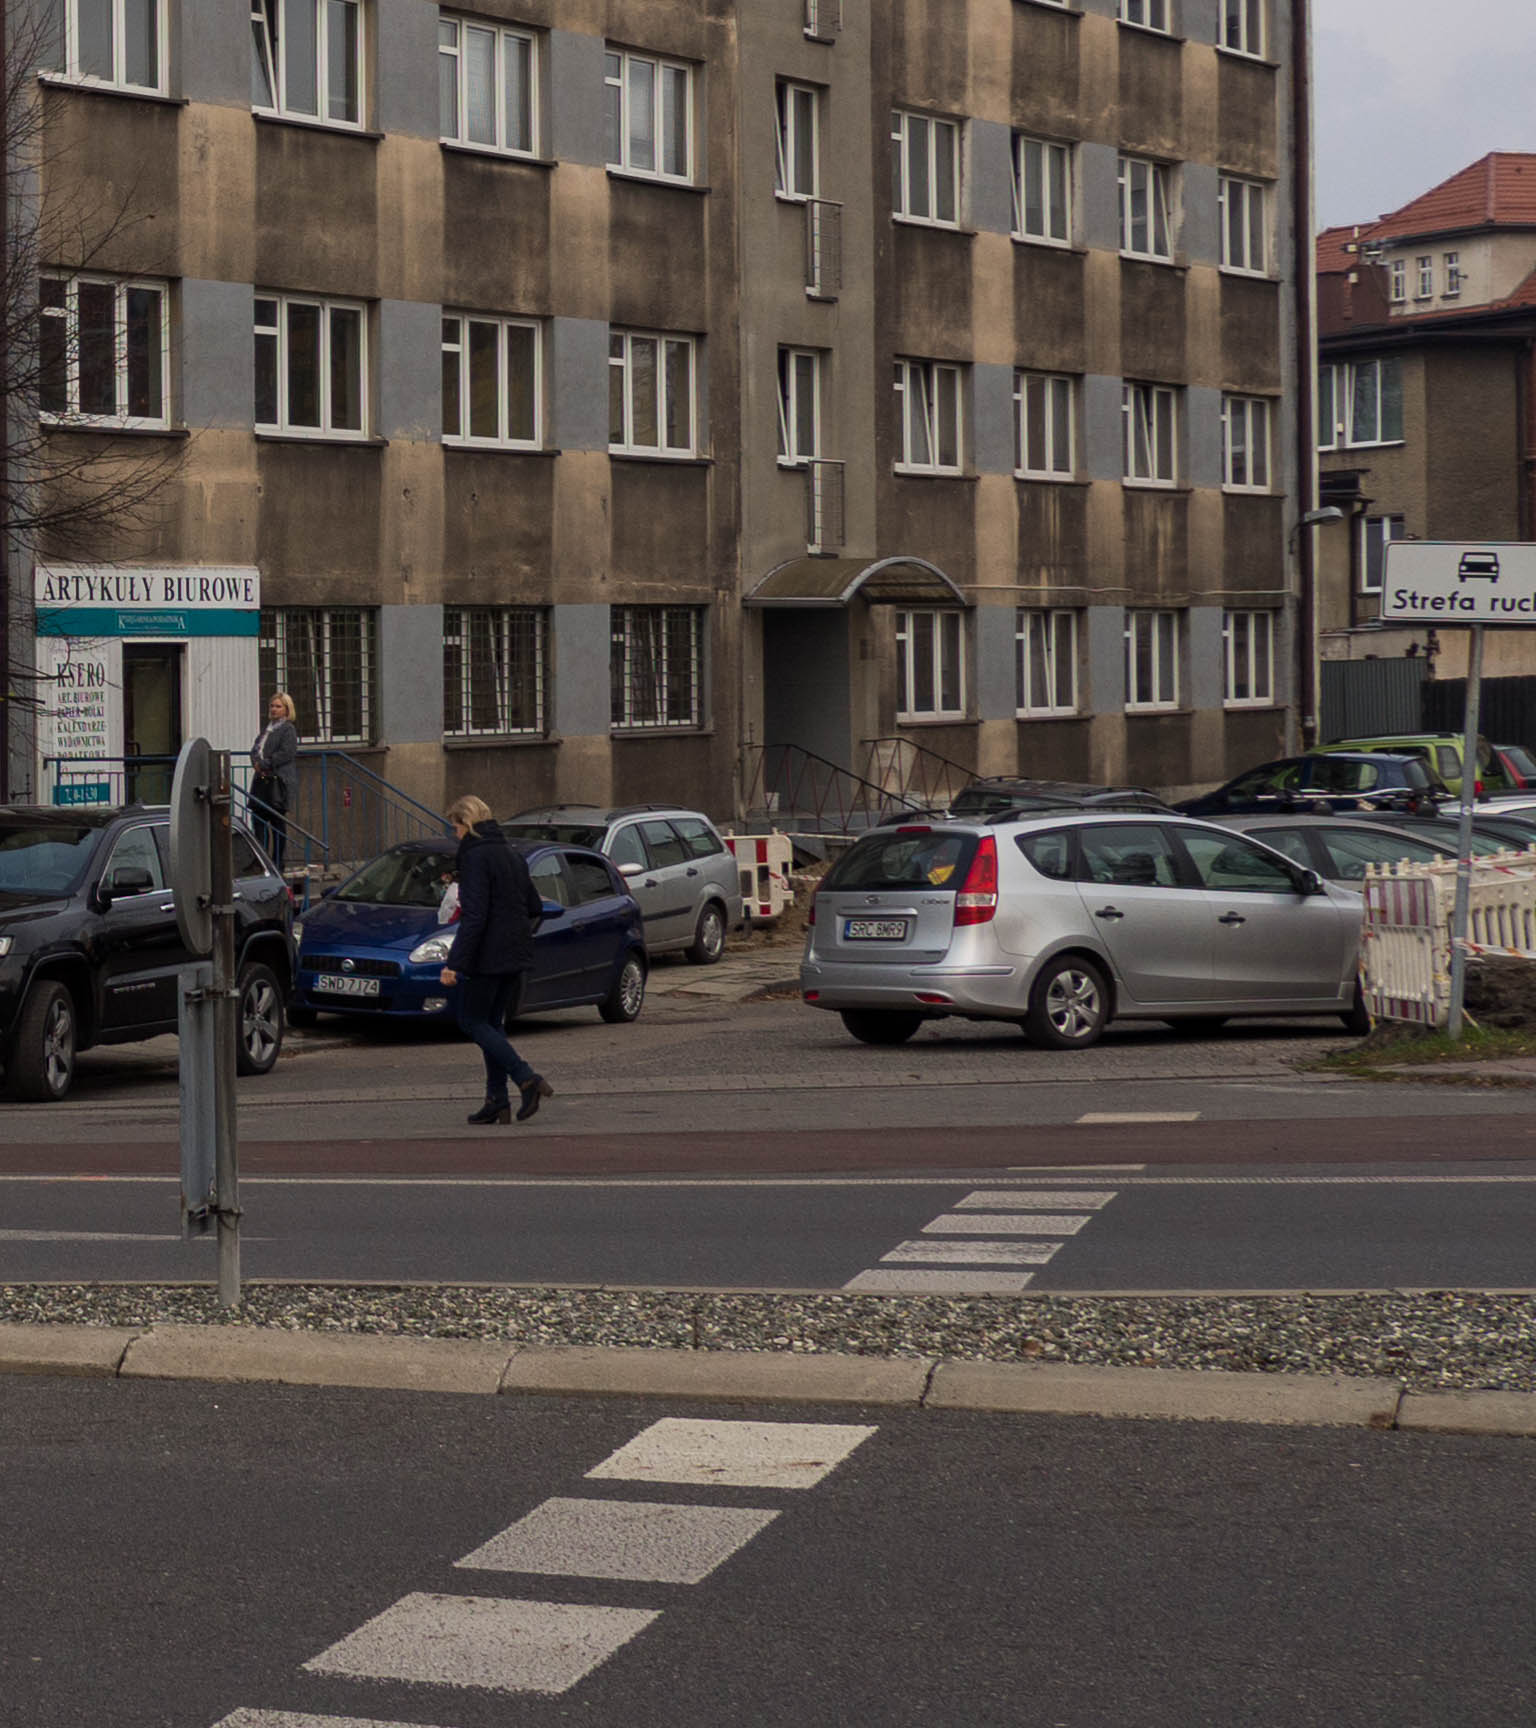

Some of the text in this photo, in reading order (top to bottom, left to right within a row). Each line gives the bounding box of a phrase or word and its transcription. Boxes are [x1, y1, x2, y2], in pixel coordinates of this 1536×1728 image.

[42, 575, 254, 602] ARTYKUŁY BIUROWE
[1392, 589, 1475, 611] Strefa
[56, 662, 106, 688] KSERO
